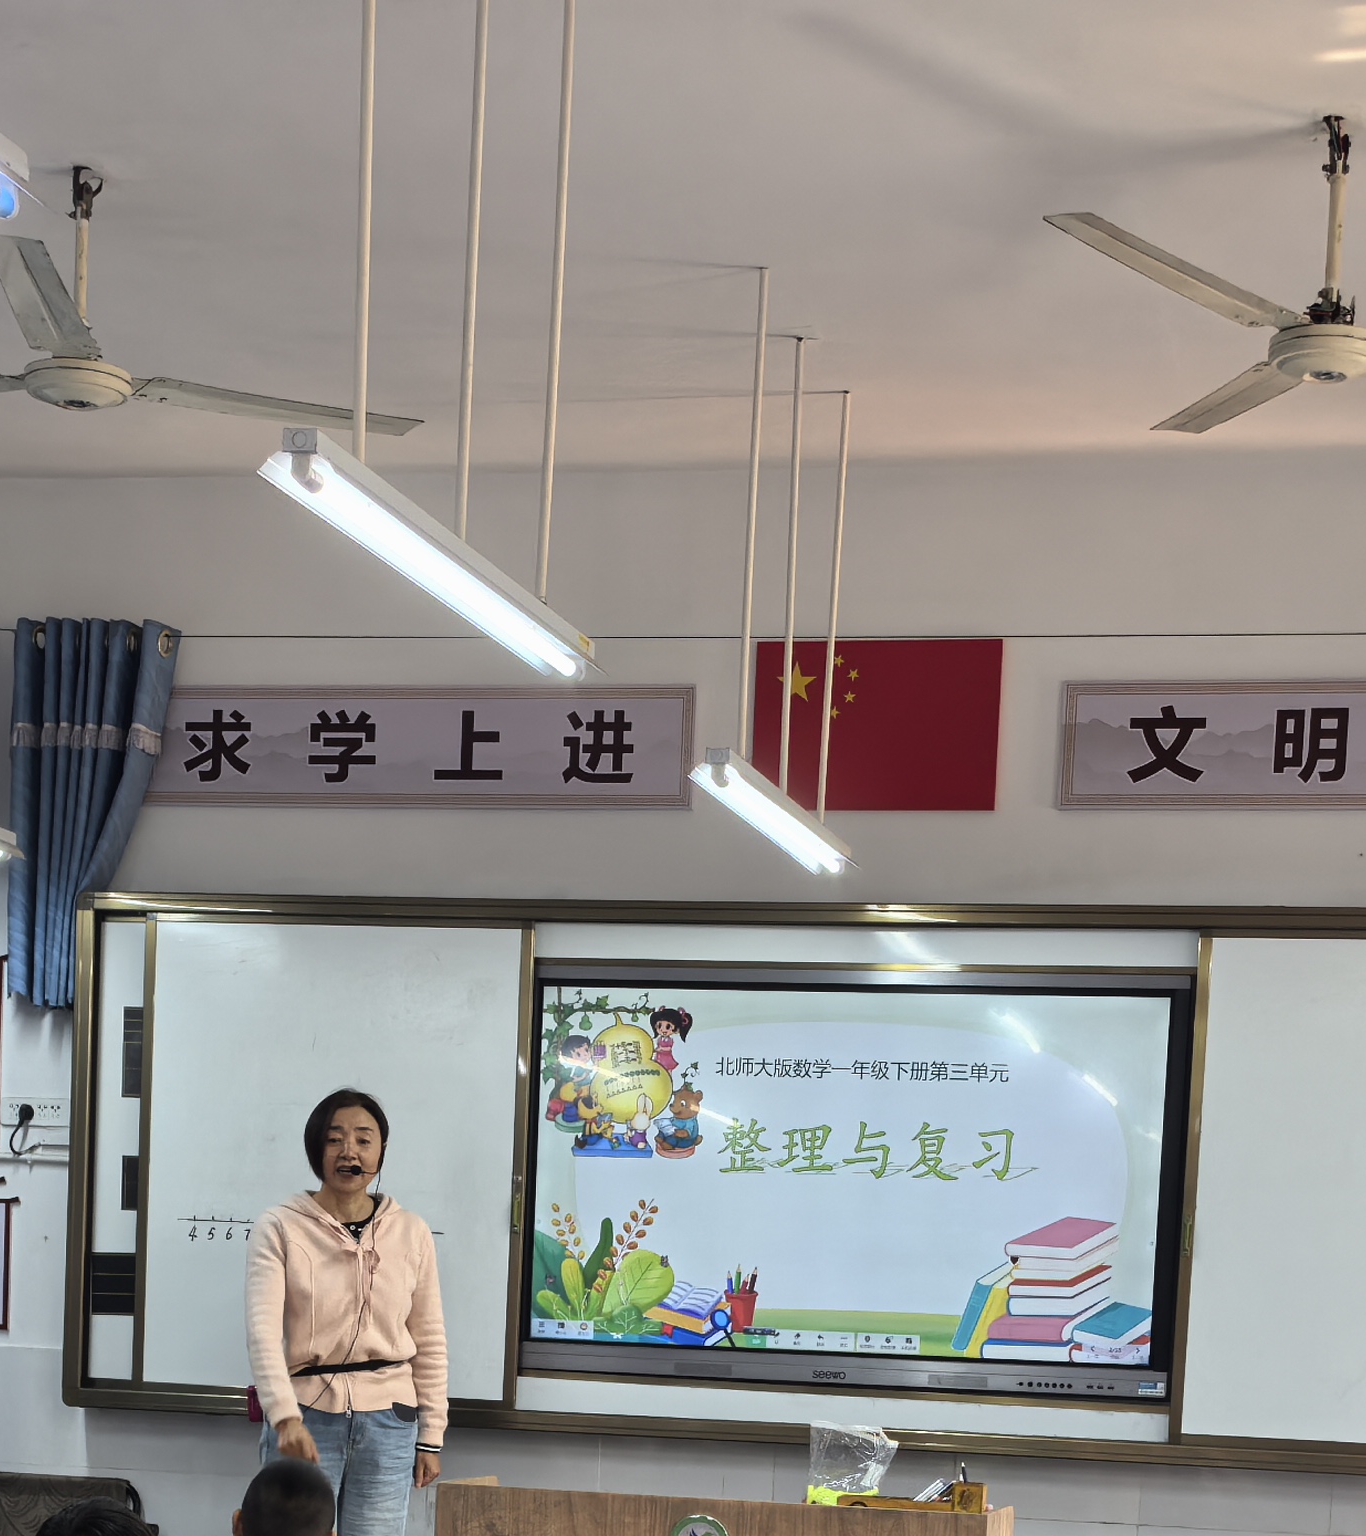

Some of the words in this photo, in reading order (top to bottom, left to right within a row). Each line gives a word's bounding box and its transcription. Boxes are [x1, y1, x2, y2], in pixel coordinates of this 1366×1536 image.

[182, 708, 635, 785] 求学上进
[715, 1056, 1010, 1083] 北师大版数学一年级下册第三单元
[717, 1117, 1016, 1181] 整理与复习
[188, 1225, 198, 1241] 4
[207, 1227, 216, 1241] 5
[225, 1227, 233, 1241] 6
[243, 1228, 251, 1241] 7
[812, 1369, 846, 1381] seewo
